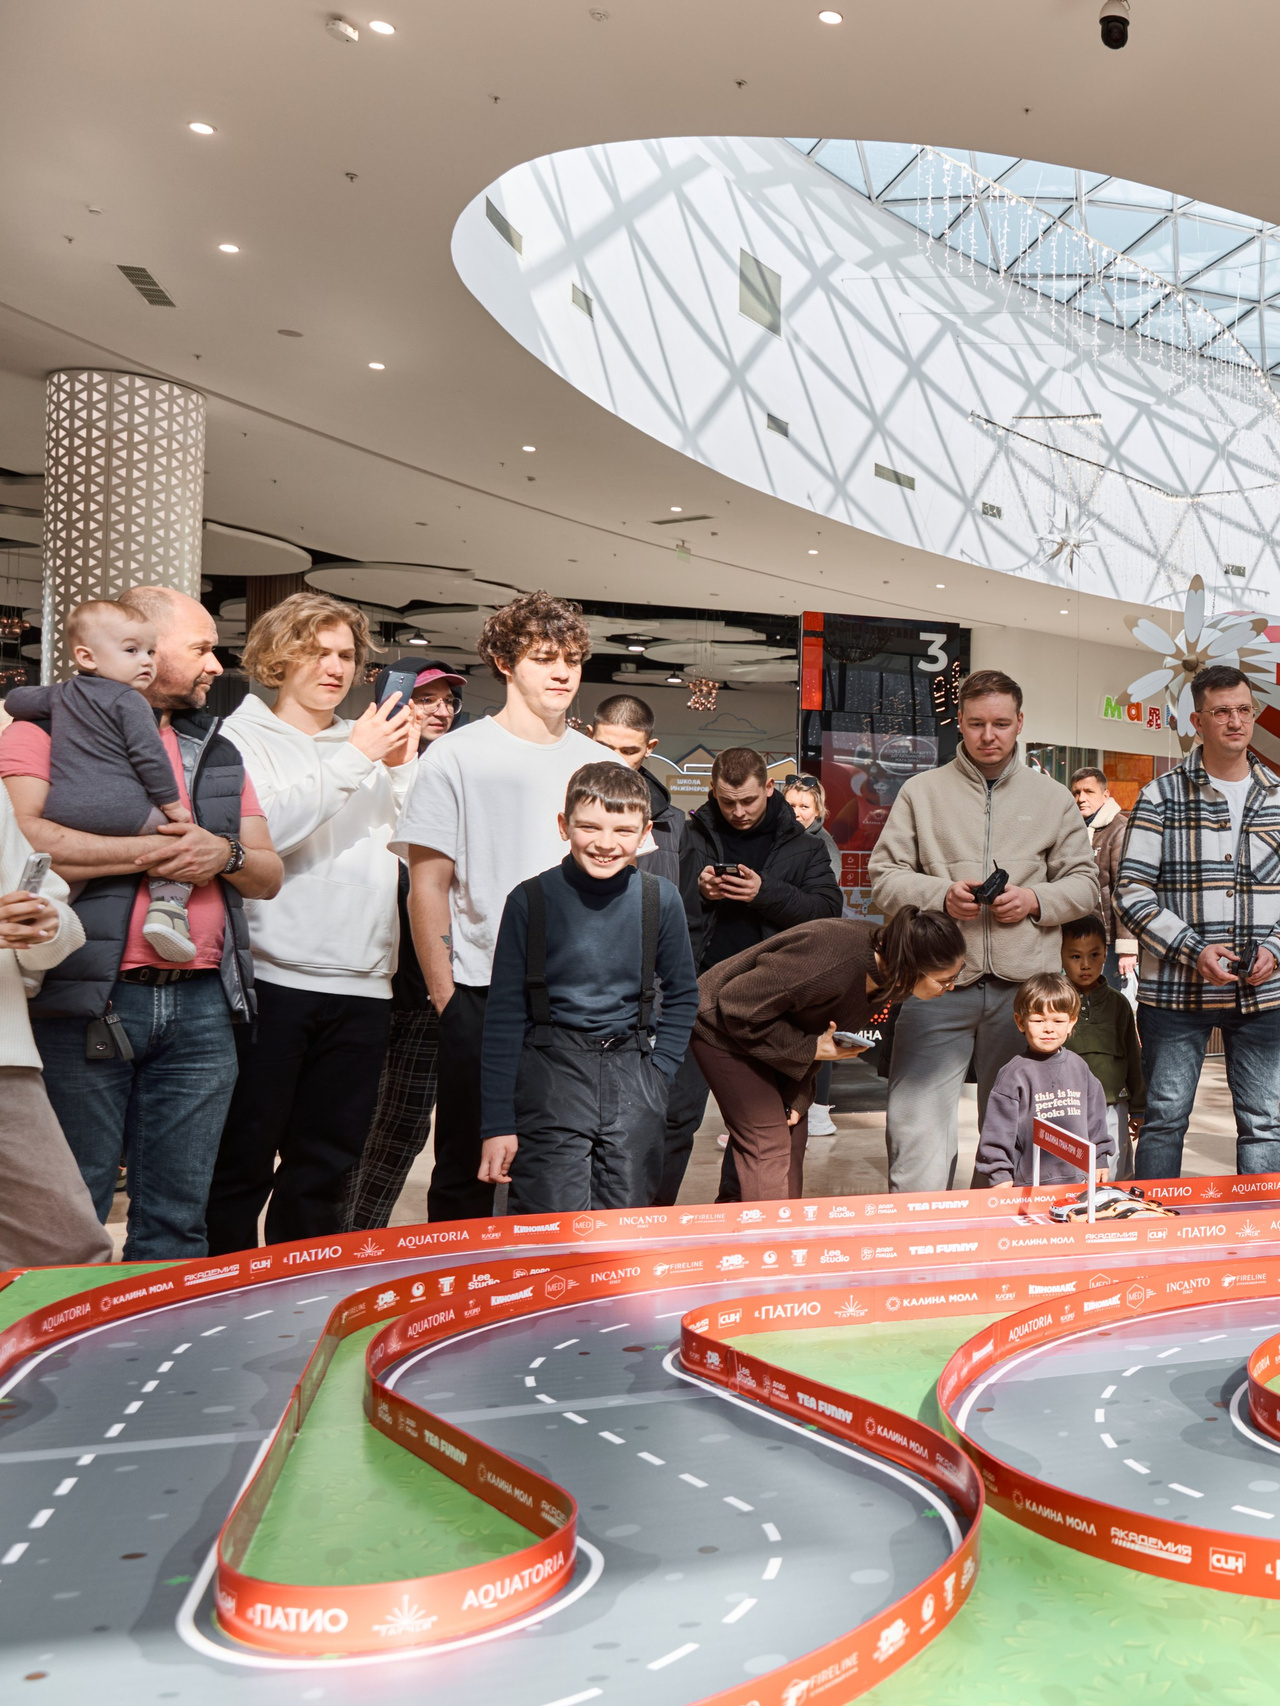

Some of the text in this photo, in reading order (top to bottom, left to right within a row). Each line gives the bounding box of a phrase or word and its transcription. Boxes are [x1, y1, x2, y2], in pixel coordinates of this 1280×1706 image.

[917, 633, 948, 672] 3
[1034, 1089, 1081, 1101] this is how
[1035, 1098, 1081, 1112] perfection
[1037, 1109, 1065, 1119] looks
[1153, 1187, 1192, 1198] ПАТИО
[1000, 1197, 1032, 1205] КАЛИНА
[619, 1215, 667, 1226] INCANTO
[829, 1210, 855, 1218] Studio
[575, 1221, 591, 1229] MED
[1183, 1225, 1226, 1238] ПАТИО
[398, 1230, 470, 1248] AQUATORIA
[1012, 1236, 1075, 1247] КАЛИНА МОЛЛ
[289, 1246, 342, 1265] ПАТИО
[909, 1242, 978, 1255] TEA FUNNY
[670, 1260, 704, 1269] FIRELINE
[820, 1254, 850, 1264] Studio
[591, 1267, 640, 1283] INCANTO
[1236, 1273, 1267, 1281] FIRELINE
[547, 1281, 564, 1293] MED
[1029, 1281, 1077, 1294] КИНОМАКС
[1166, 1278, 1210, 1293] INCANTO
[113, 1281, 174, 1306] КАЛИНА МОЛЛ
[903, 1293, 978, 1307] КАЛИНА МОЛЛ
[42, 1303, 91, 1332] AQUATORIA
[761, 1302, 821, 1319] ПАТИО
[408, 1309, 455, 1338] AQUATORIA
[1008, 1314, 1053, 1342] AQUATORIA
[797, 1392, 852, 1424] TEA FUNNY
[424, 1430, 467, 1466] TEA FUNNY
[877, 1426, 929, 1459] КАЛИНА МОЛЛ
[1025, 1498, 1097, 1536] КАЛИНА МОЛЛ
[1111, 1527, 1192, 1556] АКАДЕМИЯ
[462, 1551, 564, 1611] AQUATORIA
[255, 1603, 348, 1633] ПАТИО
[810, 1651, 859, 1688] FIRELINE
